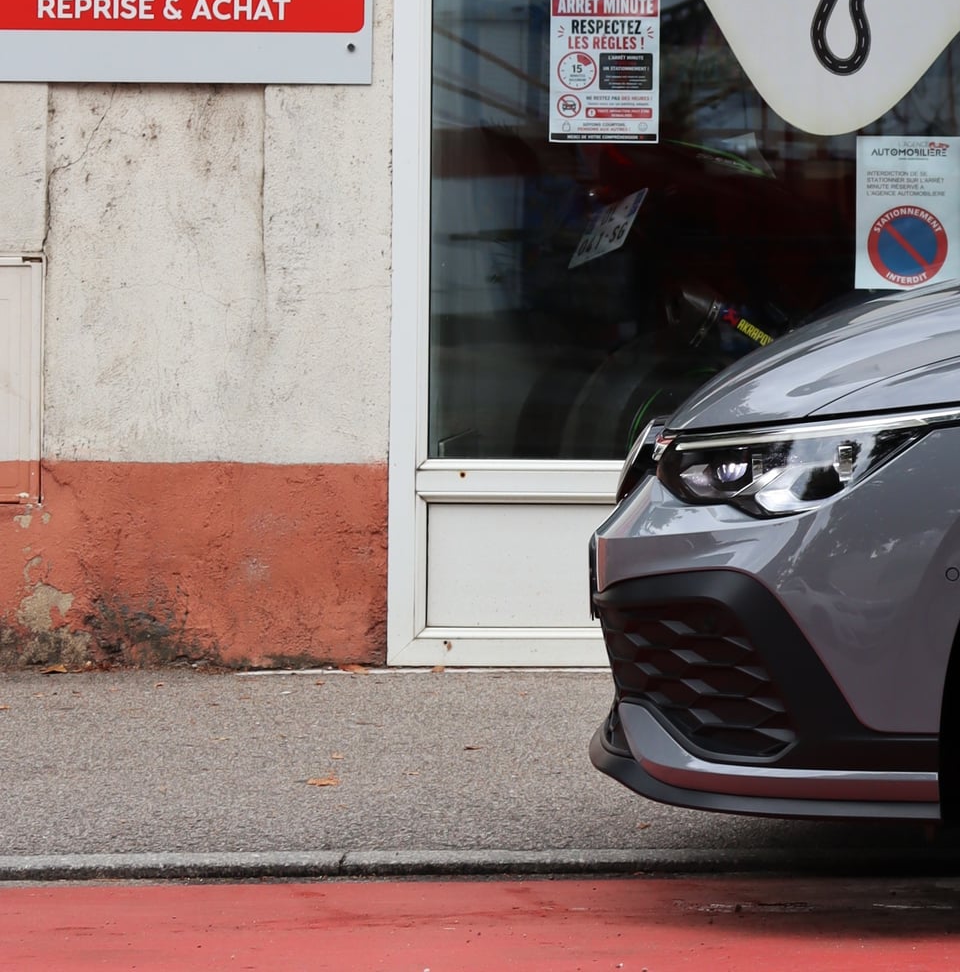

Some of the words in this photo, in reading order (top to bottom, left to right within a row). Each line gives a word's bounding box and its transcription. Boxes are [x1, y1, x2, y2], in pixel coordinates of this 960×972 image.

[571, 19, 642, 35] RESPECTEZ
[567, 36, 589, 50] LES
[640, 36, 645, 50] !
[572, 64, 583, 74] 15
[873, 207, 943, 234] STATIONNEMENT
[885, 271, 928, 285] INTERDIT
